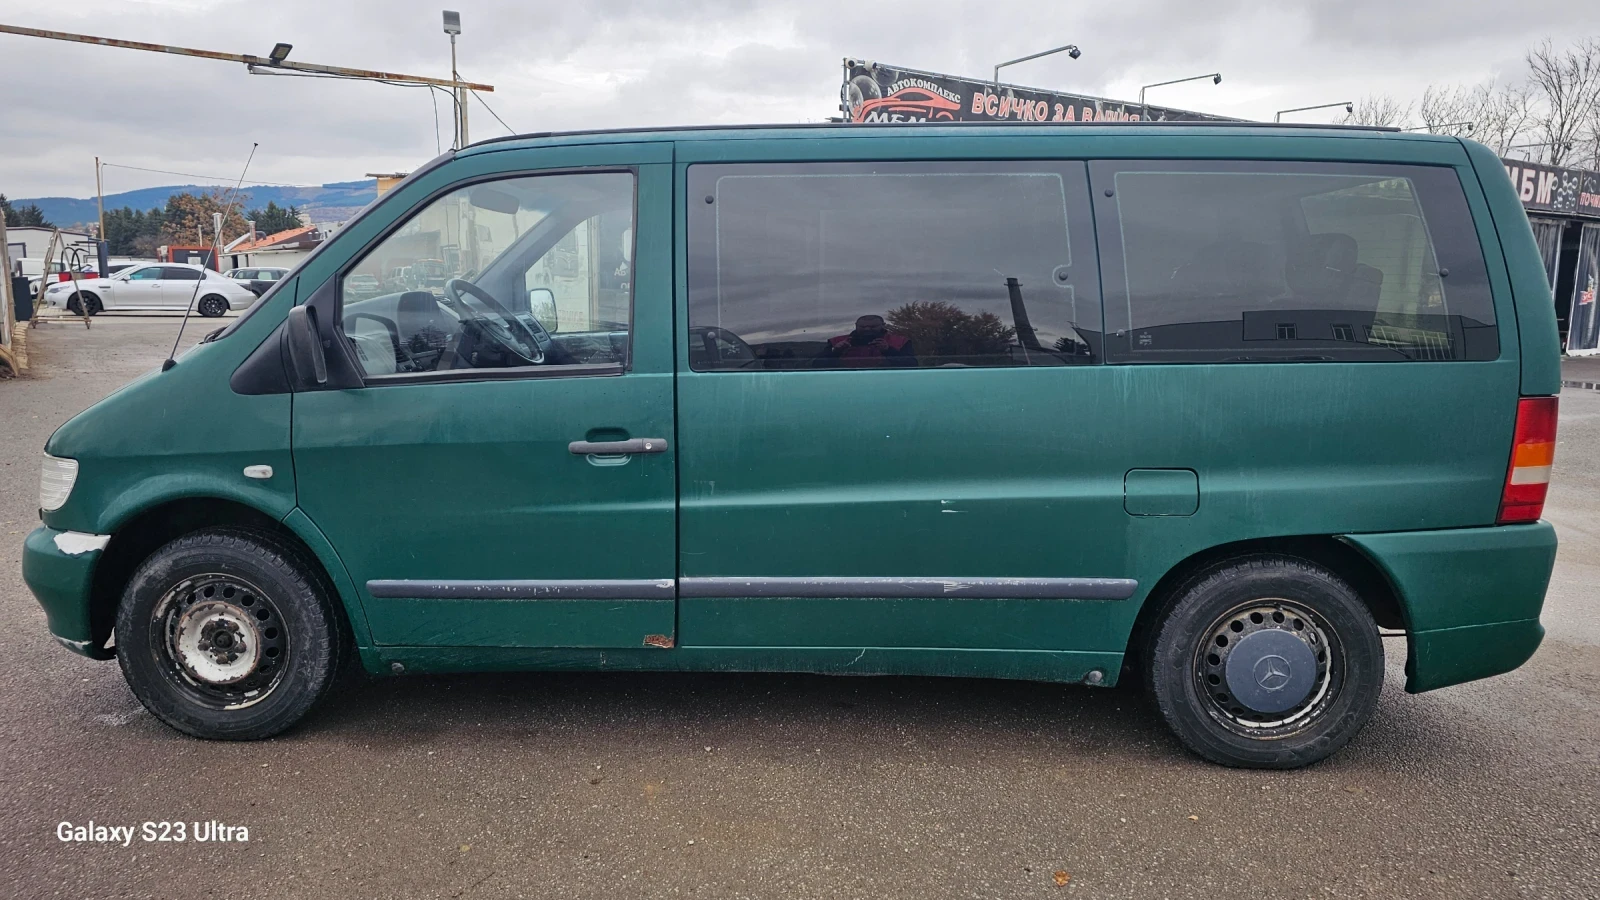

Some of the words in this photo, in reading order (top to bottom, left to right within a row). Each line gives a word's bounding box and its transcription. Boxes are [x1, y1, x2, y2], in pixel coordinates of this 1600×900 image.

[887, 78, 961, 103] АВТОКОМПЛЕКС
[971, 92, 1048, 121] ВСИЧКО
[1053, 103, 1075, 122] ЗА
